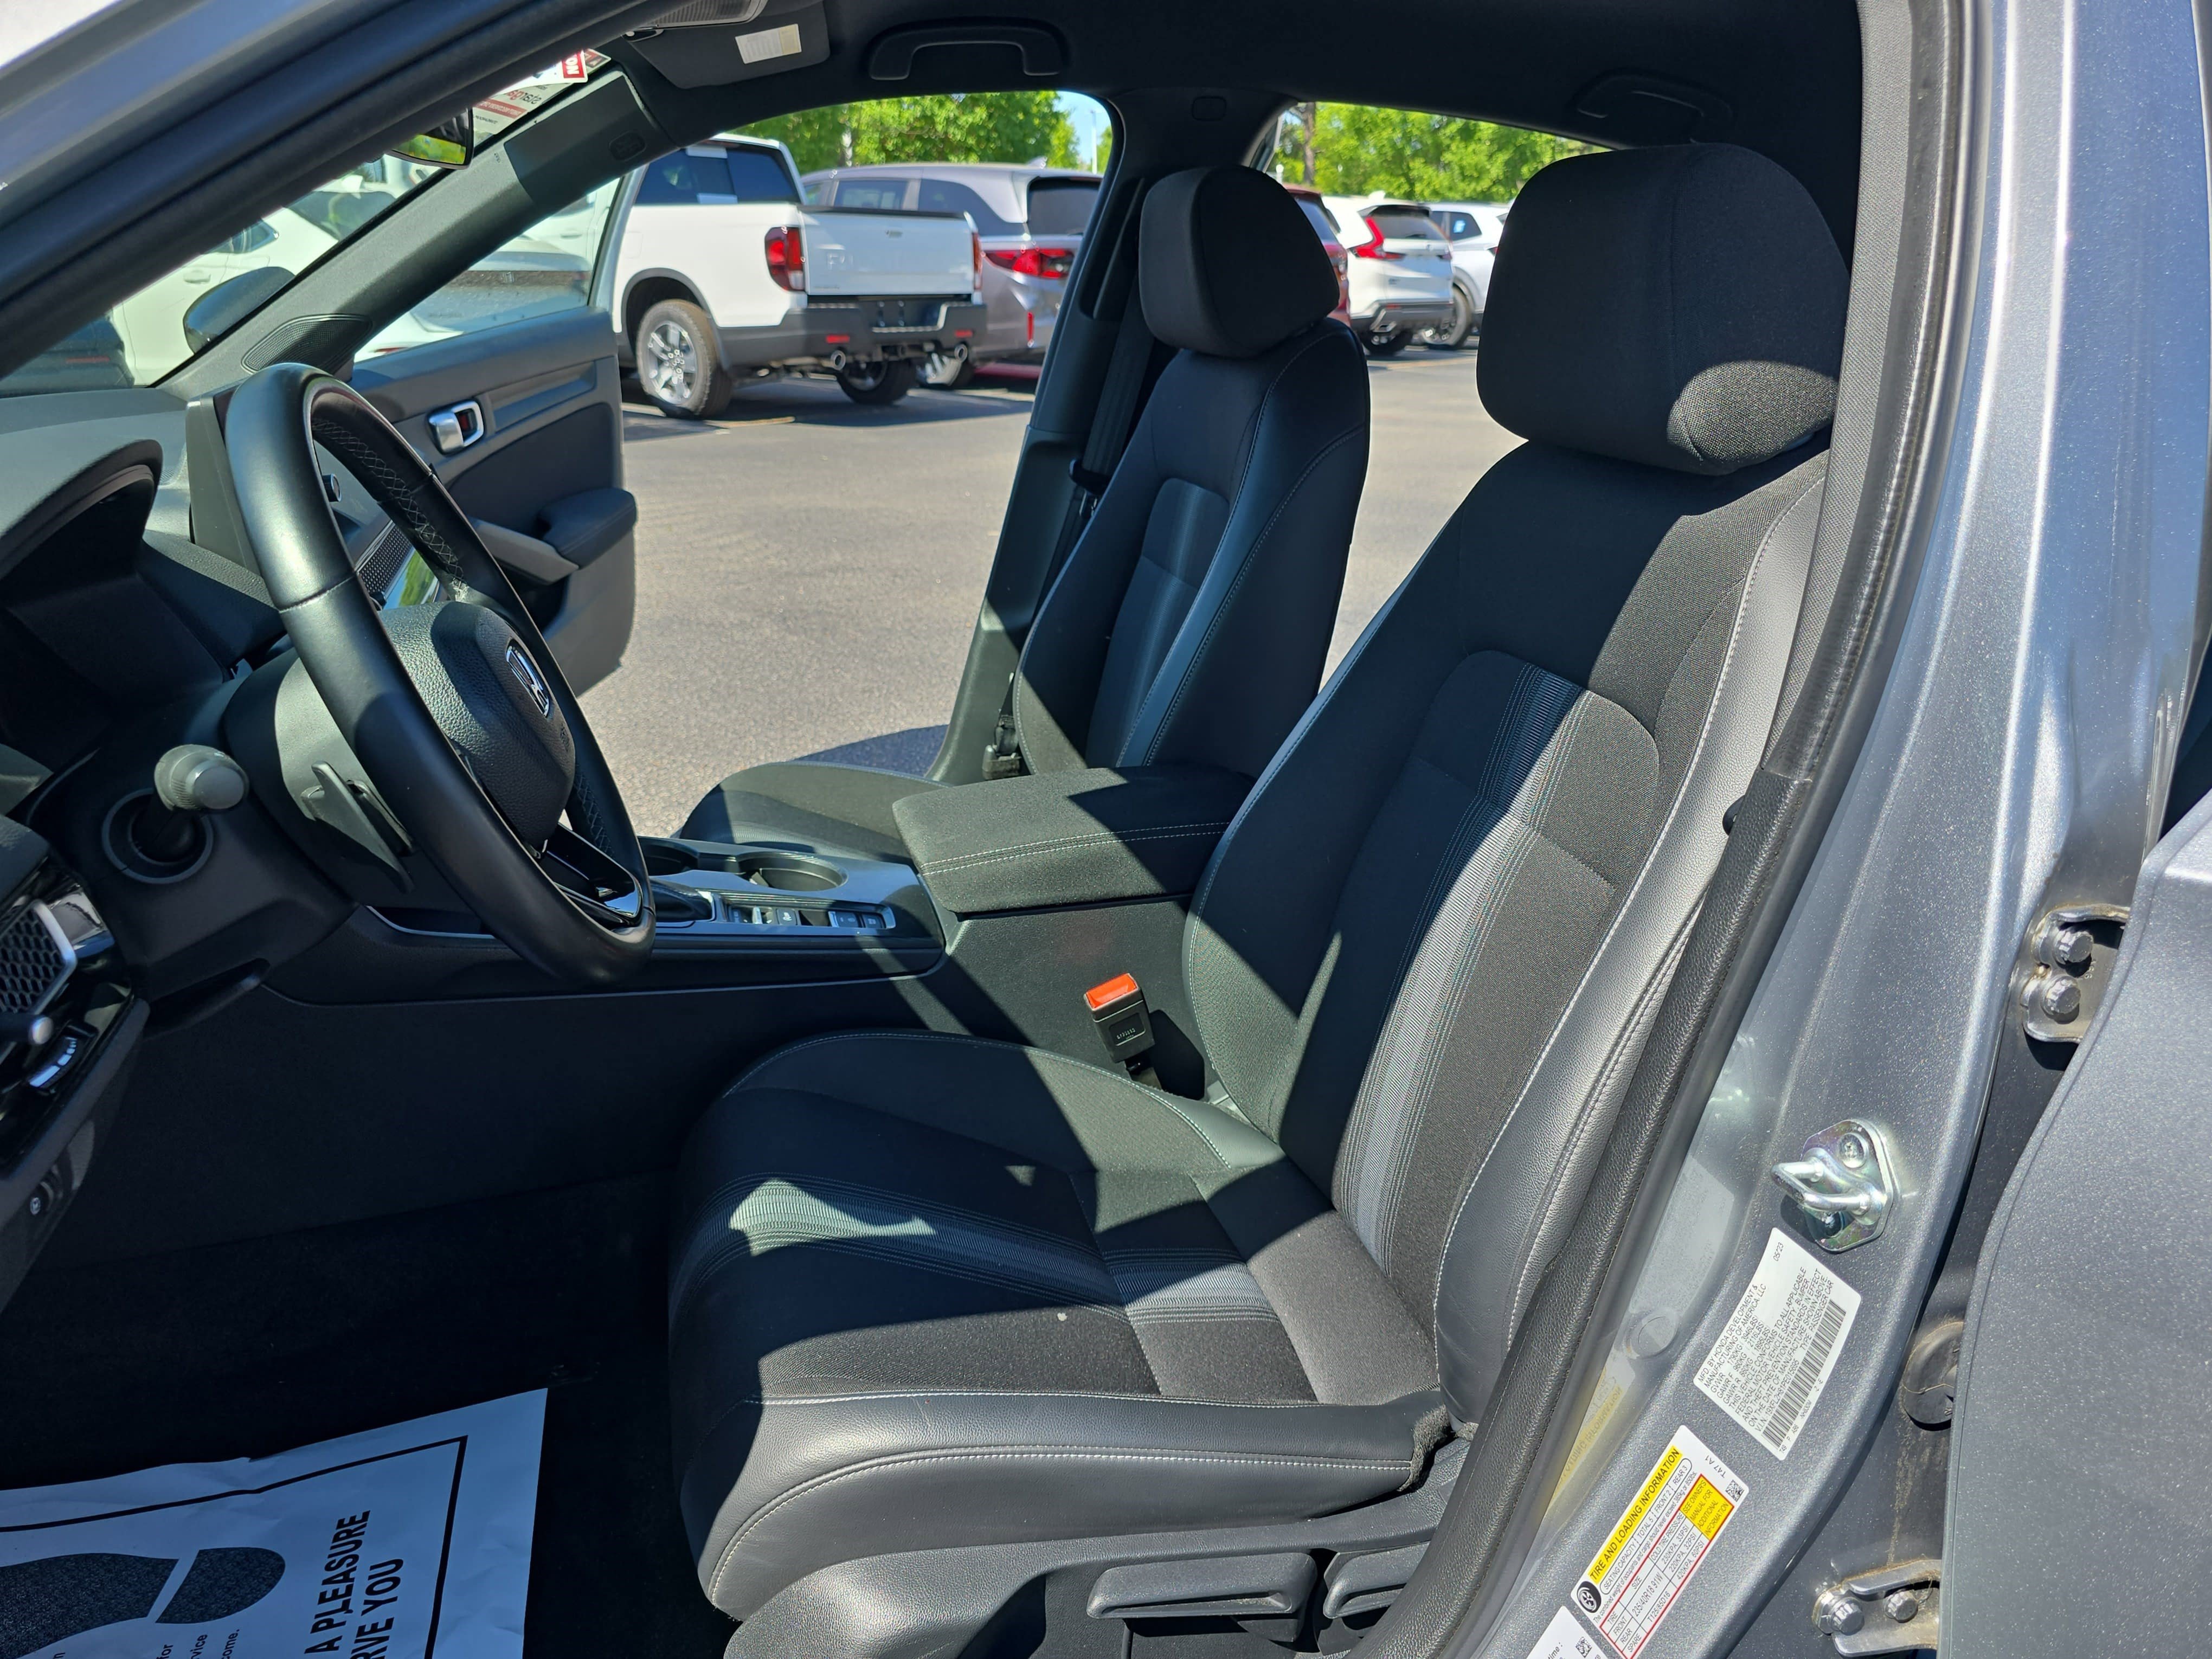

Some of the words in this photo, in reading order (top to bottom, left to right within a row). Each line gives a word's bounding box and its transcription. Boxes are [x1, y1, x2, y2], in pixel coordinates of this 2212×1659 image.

[1804, 1295, 1811, 1304] IN
[1806, 1268, 1822, 1296] EFFECT
[1808, 1293, 1828, 1332] PASSENGER
[1824, 1279, 1834, 1295] CAR
[1697, 1365, 1711, 1382] MFD.
[1707, 1356, 1715, 1367] BY
[1713, 1334, 1729, 1358] HONDA
[1726, 1289, 1754, 1336] DEVELOPMENT
[1703, 1334, 1738, 1388] MANUFACTURING
[1734, 1324, 1744, 1337] OF
[1756, 1282, 1766, 1297] LLC
[1728, 1392, 1741, 1410] THIS
[1738, 1365, 1757, 1395] VEHICLE
[1753, 1328, 1778, 1368] CONFORMS
[1774, 1318, 1783, 1330] TO
[1779, 1306, 1789, 1320] ALL
[1785, 1266, 1806, 1309] APPLICABLE
[1784, 1303, 1808, 1345] STANDARDS
[1709, 1371, 1725, 1393] GVWR
[1727, 1342, 1742, 1366] 1790KG
[1735, 1385, 1756, 1416] FEDERAL
[1752, 1360, 1770, 1387] MOTOR
[1766, 1333, 1784, 1363] VEHICLE
[1747, 1414, 1758, 1428] ON
[1754, 1401, 1766, 1417] THE
[1762, 1384, 1776, 1403] DATE
[1772, 1373, 1781, 1386] OF
[1777, 1324, 1806, 1375] MANUFACTURE
[1802, 1298, 1817, 1327] SHOWN
[1813, 1273, 1828, 1301] ABOVE.
[1762, 1342, 1788, 1386] PREVENTION
[1716, 1377, 1731, 1399] GAWR
[1722, 1382, 1738, 1405] GAWR
[1741, 1405, 1753, 1422] AND
[1750, 1384, 1765, 1407] THEFT
[1713, 1463, 1727, 1478] T47
[1590, 1559, 1606, 1581] TIRE
[1602, 1540, 1618, 1562] AND
[1615, 1503, 1643, 1544] LOADING
[1639, 1448, 1680, 1507] INFORMATION
[1603, 1566, 1621, 1590] SEATING
[1617, 1541, 1637, 1569] CAPACITY
[1637, 1520, 1651, 1539] TOTAL
[1654, 1493, 1669, 1513] FRONT
[1672, 1468, 1685, 1486] REAR
[1682, 1501, 1692, 1514] SEE
[1689, 1499, 1705, 1521] MANUAL
[1702, 1488, 1713, 1502] FOR
[1696, 1498, 1718, 1529] ADDITIONAL
[1703, 1501, 1728, 1536] INFORMATION
[310, 1510, 370, 1634] PLEASURE
[361, 1559, 403, 1616] YOU
[1593, 1613, 1601, 1624] The
[1598, 1594, 1613, 1616] combined
[1622, 1558, 1639, 1581] occupants
[1635, 1549, 1643, 1561] and
[1641, 1540, 1651, 1554] cargo
[1648, 1526, 1660, 1542] should
[1656, 1515, 1667, 1529] never
[1663, 1500, 1676, 1518] exceed
[1607, 1611, 1618, 1625] TIRE
[1631, 1574, 1642, 1590] SIZE
[1650, 1545, 1662, 1561] COLD
[1658, 1535, 1669, 1548] TIRE
[1665, 1512, 1684, 1538] PRESSURE
[1613, 1615, 1628, 1636] FRONT
[1631, 1584, 1655, 1617] 235/40R18
[1650, 1572, 1663, 1589] 91W
[1675, 1523, 1689, 1542] 33PSI
[1619, 1627, 1632, 1644] REAR
[1683, 1532, 1697, 1551] 32PSI
[1626, 1633, 1641, 1653] SPARE
[1647, 1590, 1670, 1623] T125/85D16
[1690, 1539, 1705, 1558] 60PSI
[304, 1635, 343, 1654] A
